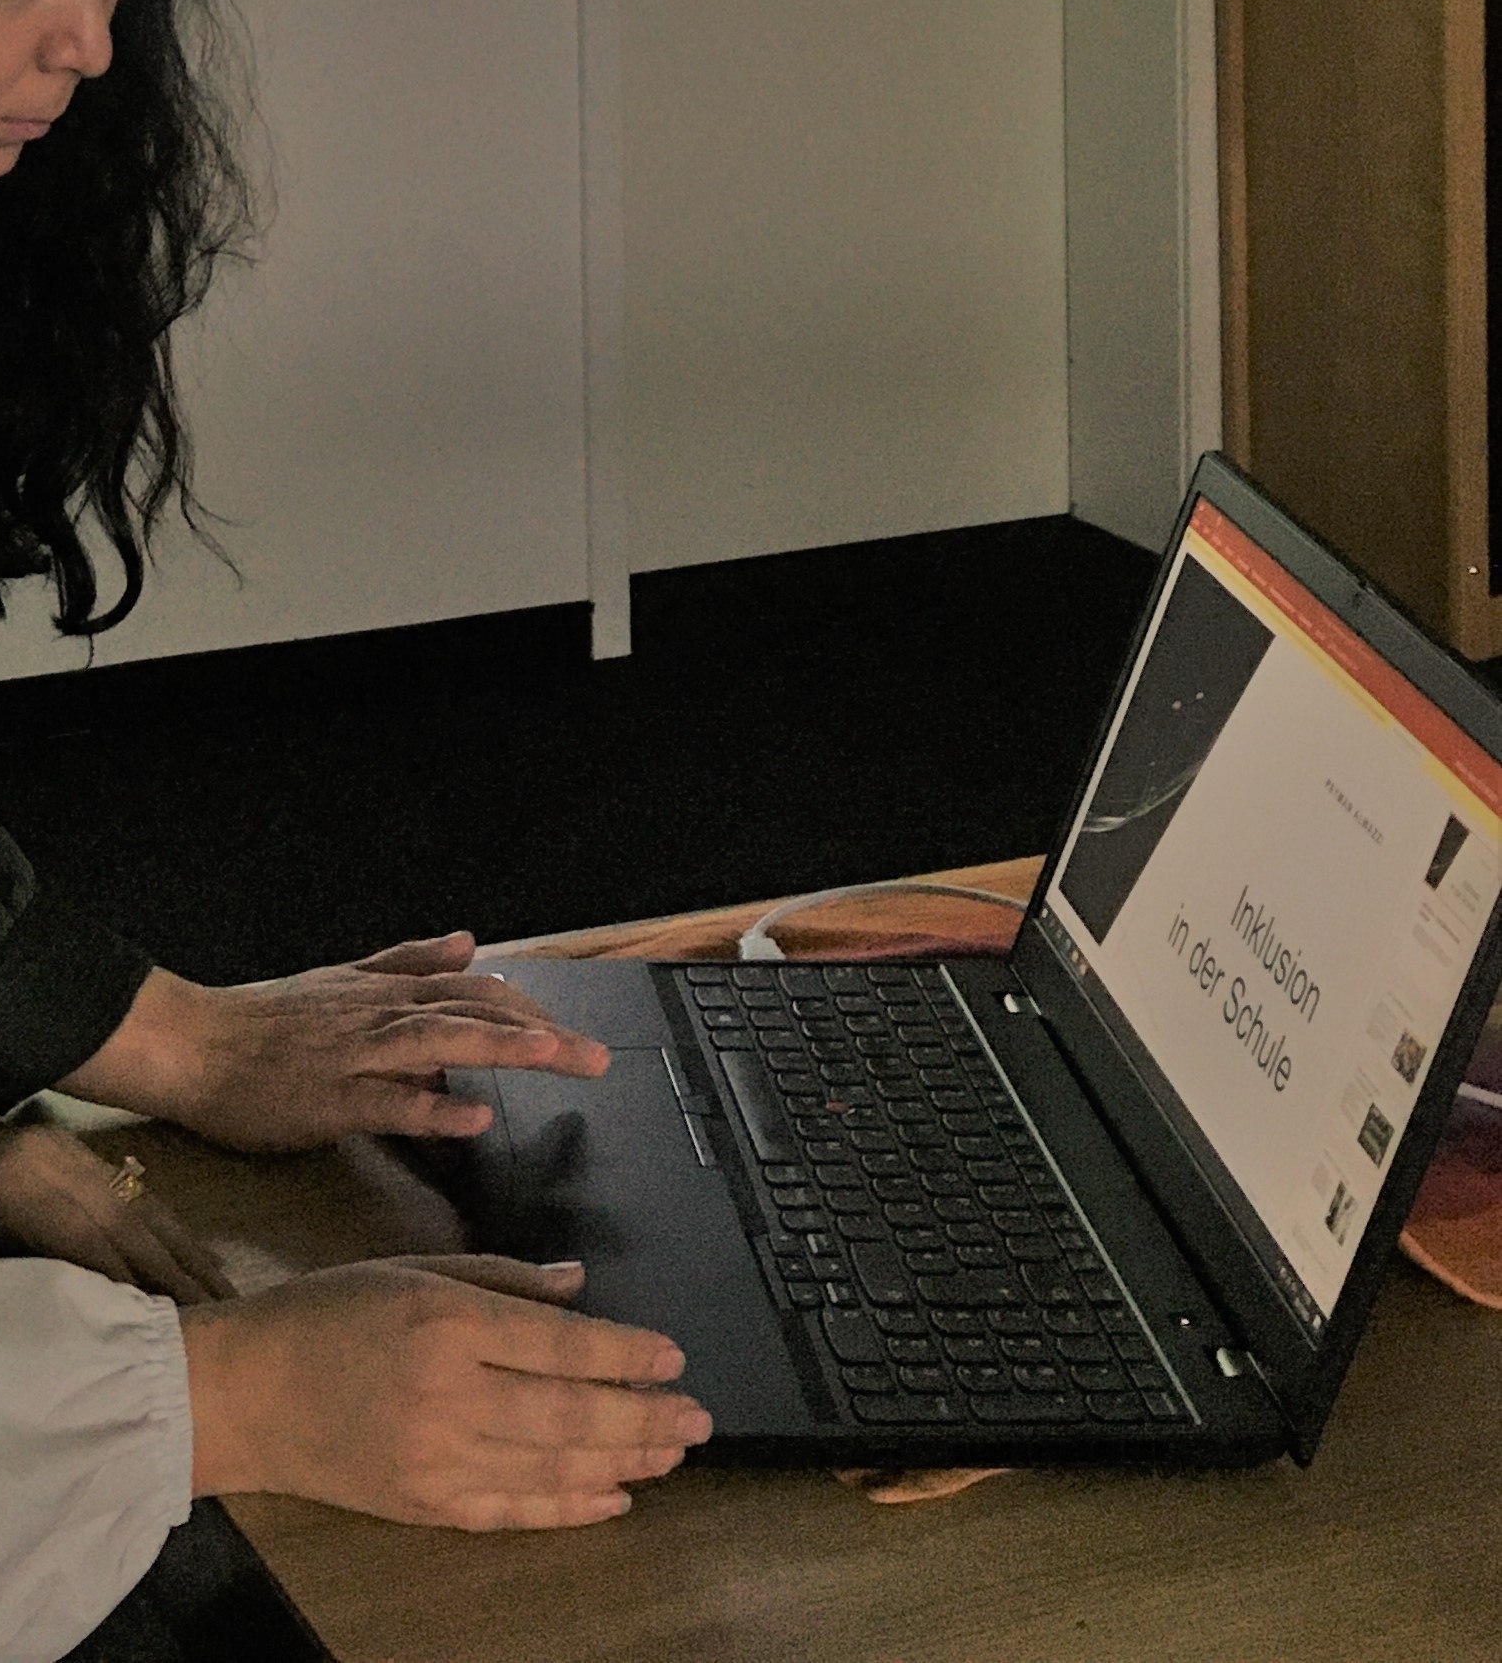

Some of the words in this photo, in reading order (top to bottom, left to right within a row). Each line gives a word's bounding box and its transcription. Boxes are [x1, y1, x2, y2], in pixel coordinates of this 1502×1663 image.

[1168, 903, 1190, 957] in
[1189, 938, 1226, 998] der
[1223, 976, 1292, 1092] Schule
[1231, 885, 1321, 1024] Inklusion
